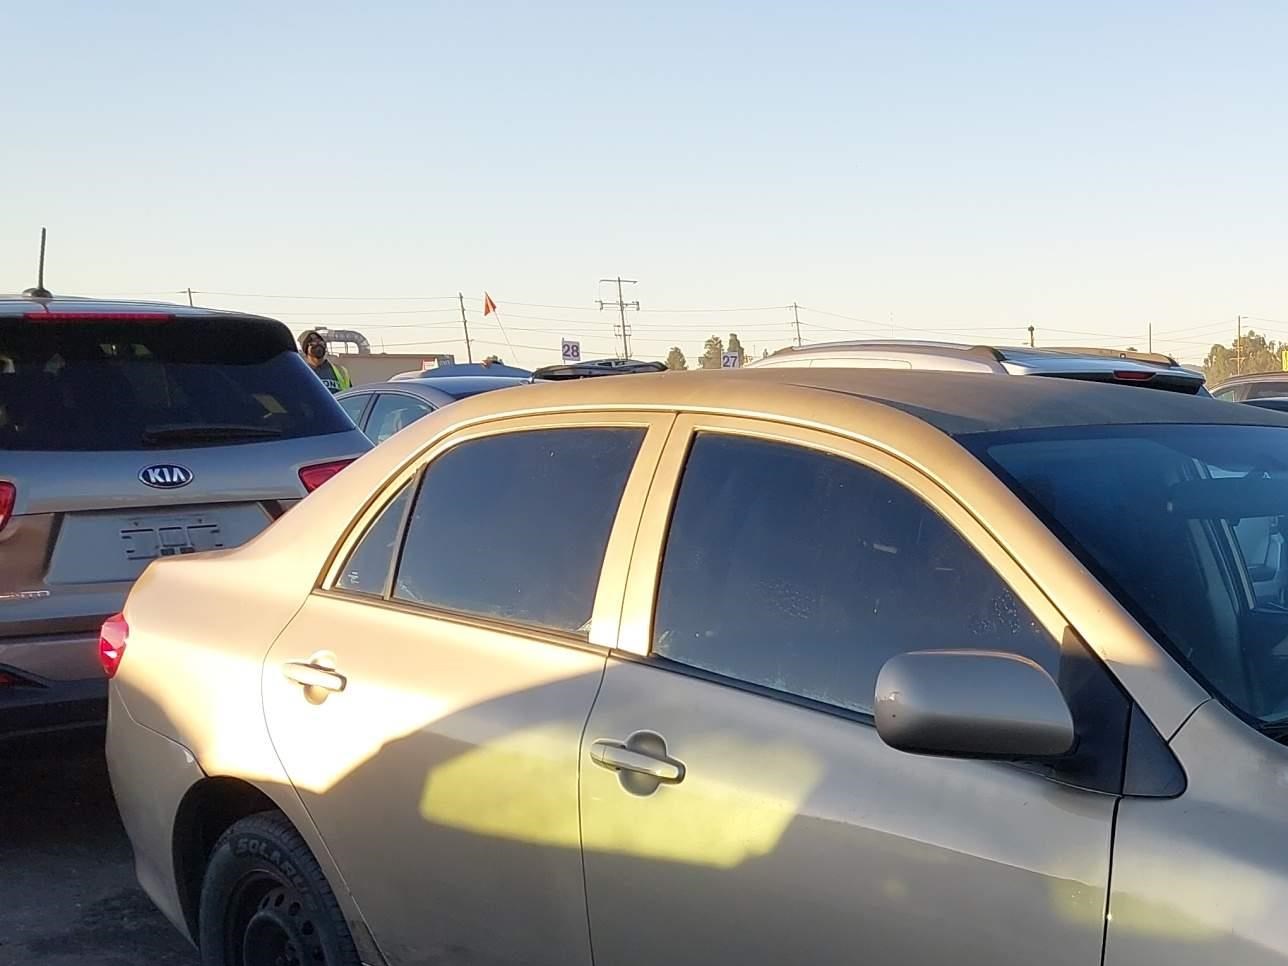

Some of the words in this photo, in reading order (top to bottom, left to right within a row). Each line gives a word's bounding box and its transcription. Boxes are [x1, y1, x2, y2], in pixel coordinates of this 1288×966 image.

[561, 343, 580, 358] 28
[722, 355, 738, 368] 27
[146, 466, 187, 483] KIA
